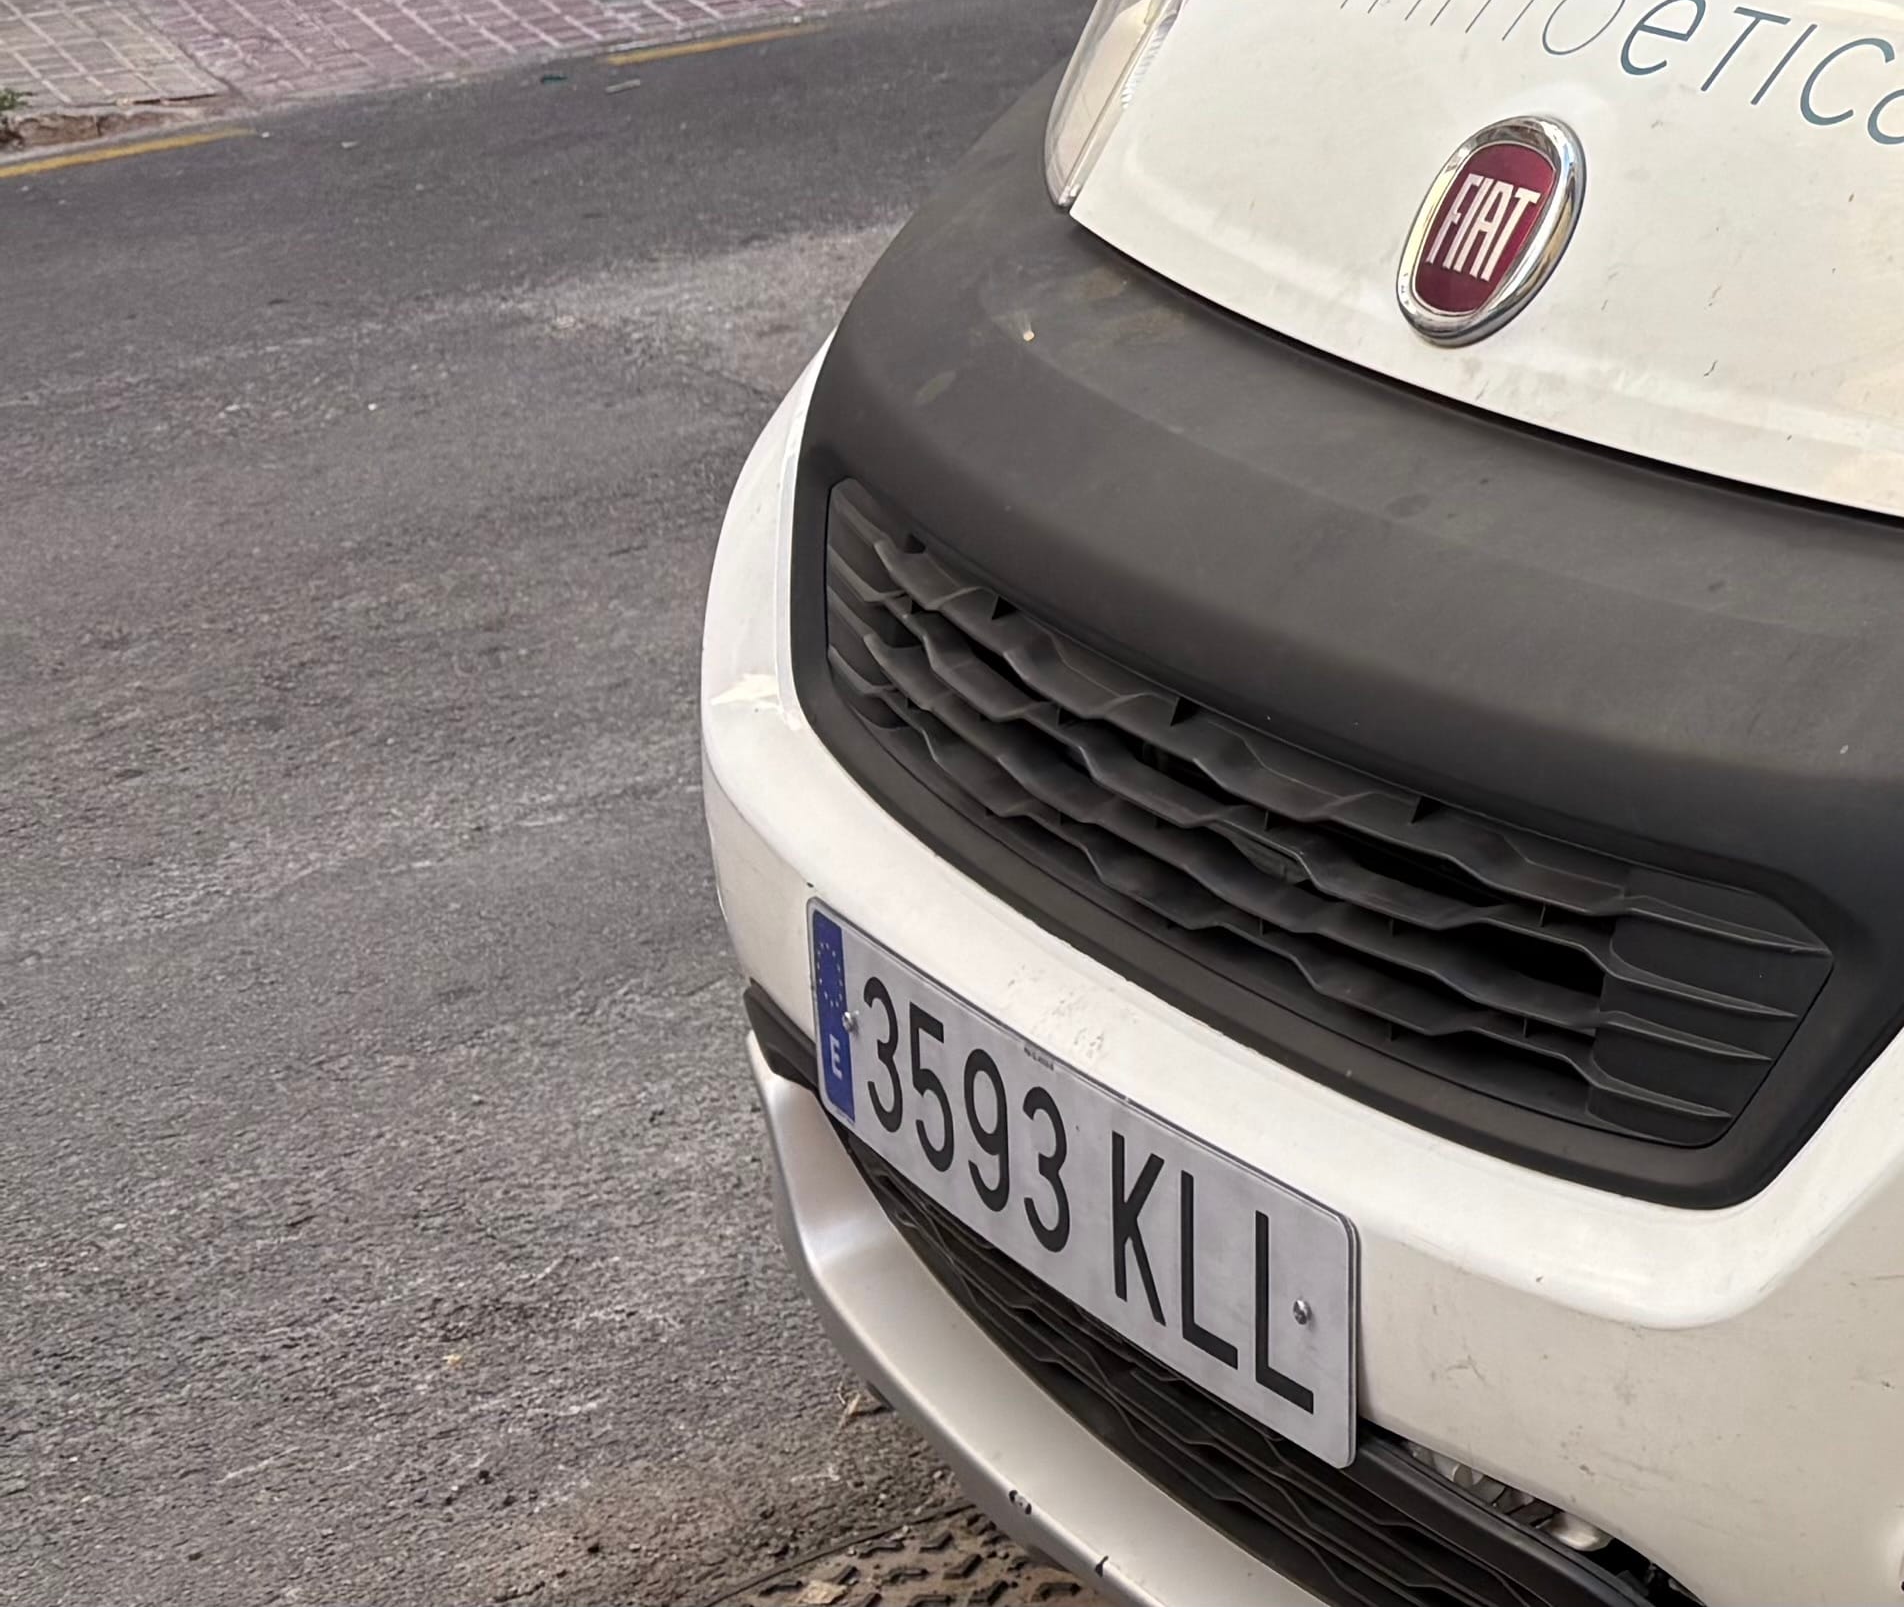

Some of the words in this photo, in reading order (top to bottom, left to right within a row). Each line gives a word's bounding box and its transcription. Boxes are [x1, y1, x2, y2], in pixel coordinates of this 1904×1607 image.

[1425, 172, 1541, 282] FIAT
[829, 1033, 843, 1082] E
[862, 976, 1071, 1254] 3593
[1111, 1128, 1315, 1415] KLL
